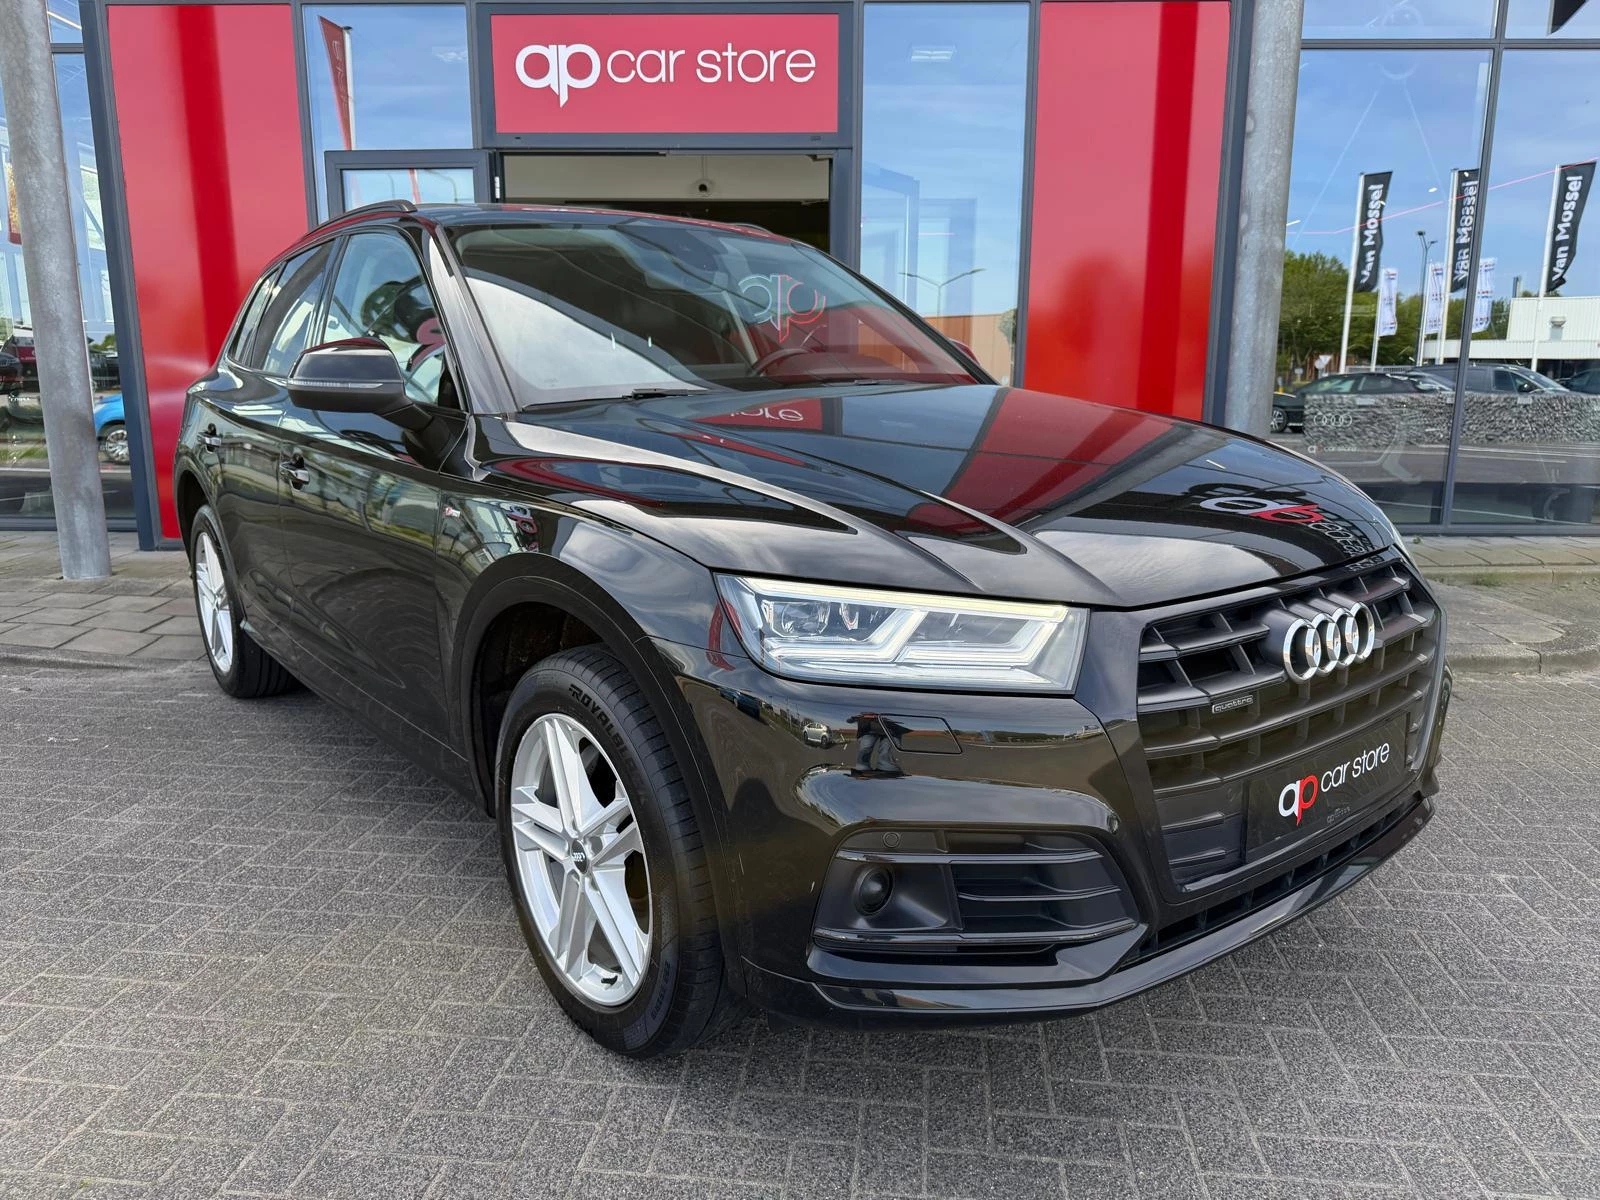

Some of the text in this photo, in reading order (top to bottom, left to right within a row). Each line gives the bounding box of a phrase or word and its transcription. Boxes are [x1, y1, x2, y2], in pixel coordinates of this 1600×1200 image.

[515, 42, 817, 108] ap car store
[1364, 183, 1384, 247] Mossel
[1551, 175, 1583, 281] Van Mossel
[1278, 774, 1319, 827] ap
[1320, 761, 1350, 792] car
[1351, 742, 1390, 778] store
